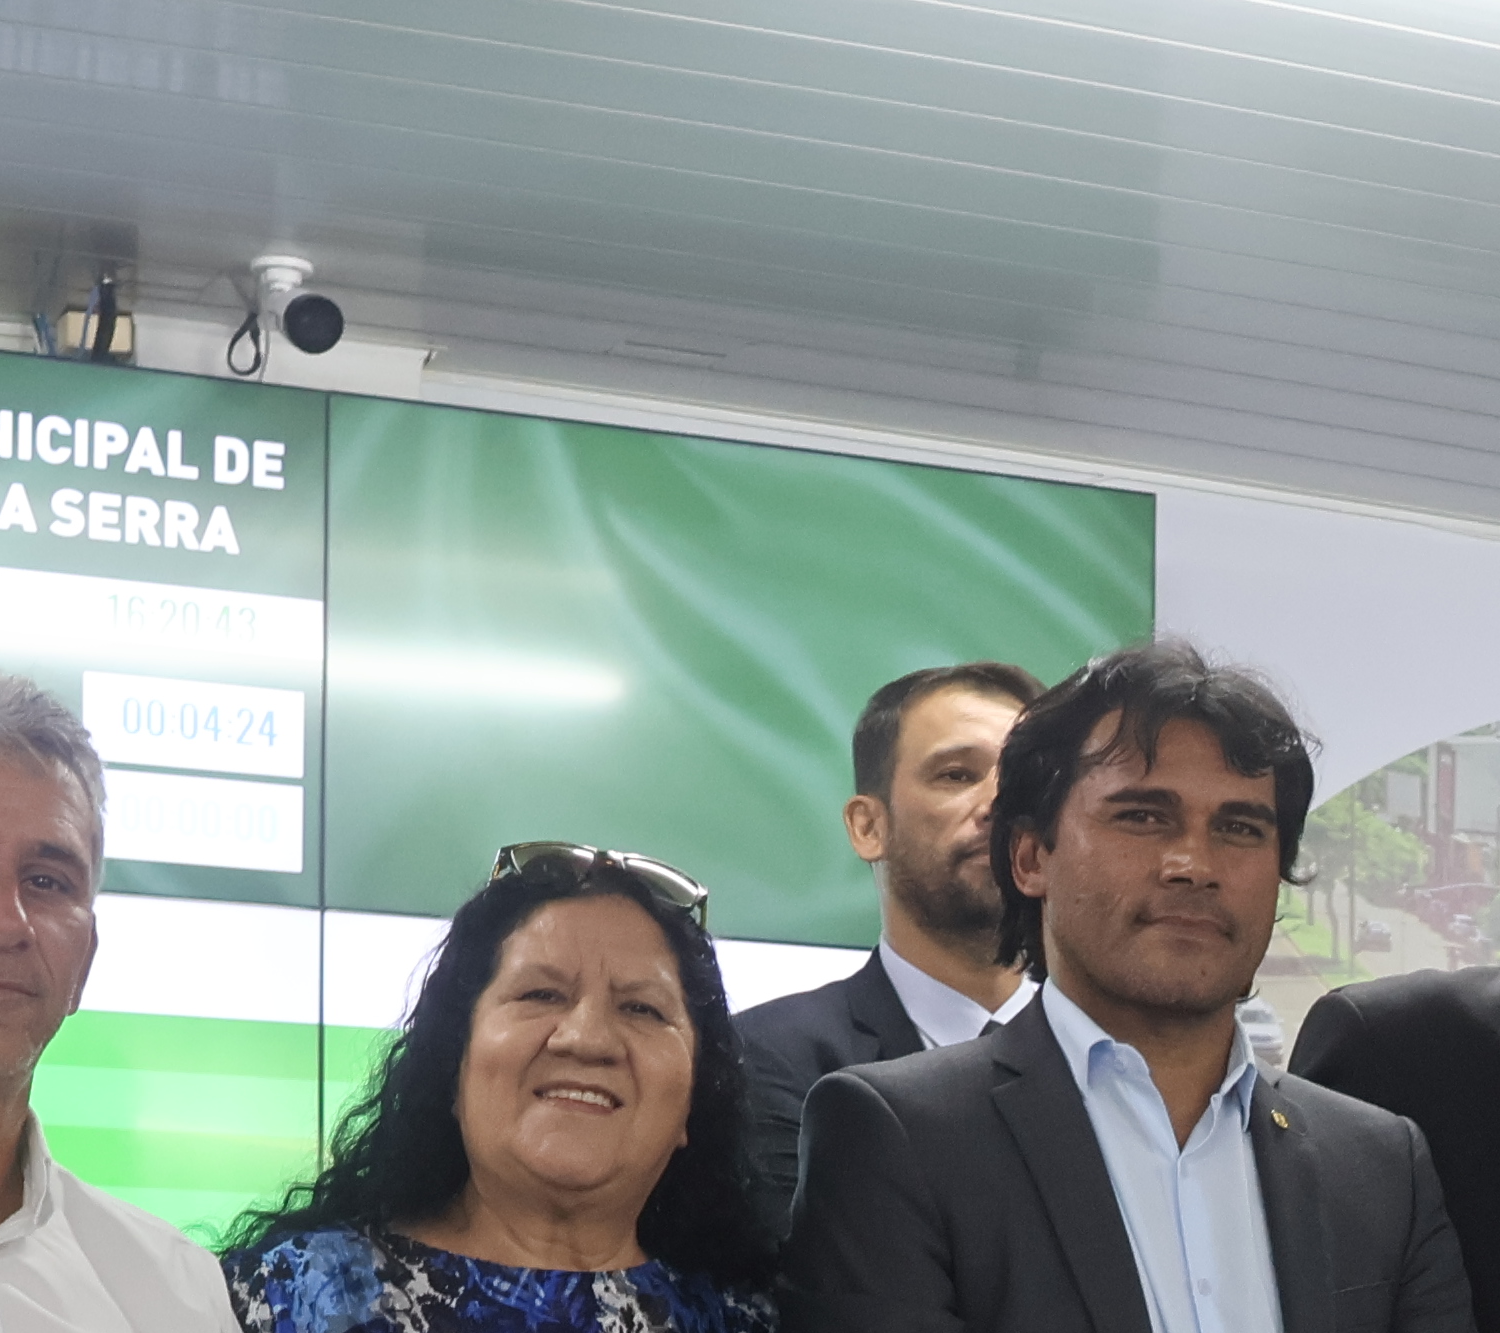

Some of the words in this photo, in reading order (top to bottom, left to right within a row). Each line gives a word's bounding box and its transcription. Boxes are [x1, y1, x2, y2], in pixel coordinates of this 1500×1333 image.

[214, 435, 285, 490] DE
[49, 488, 240, 555] SERRA
[108, 594, 256, 643] 16:20:43
[123, 697, 278, 748] 00:04:24
